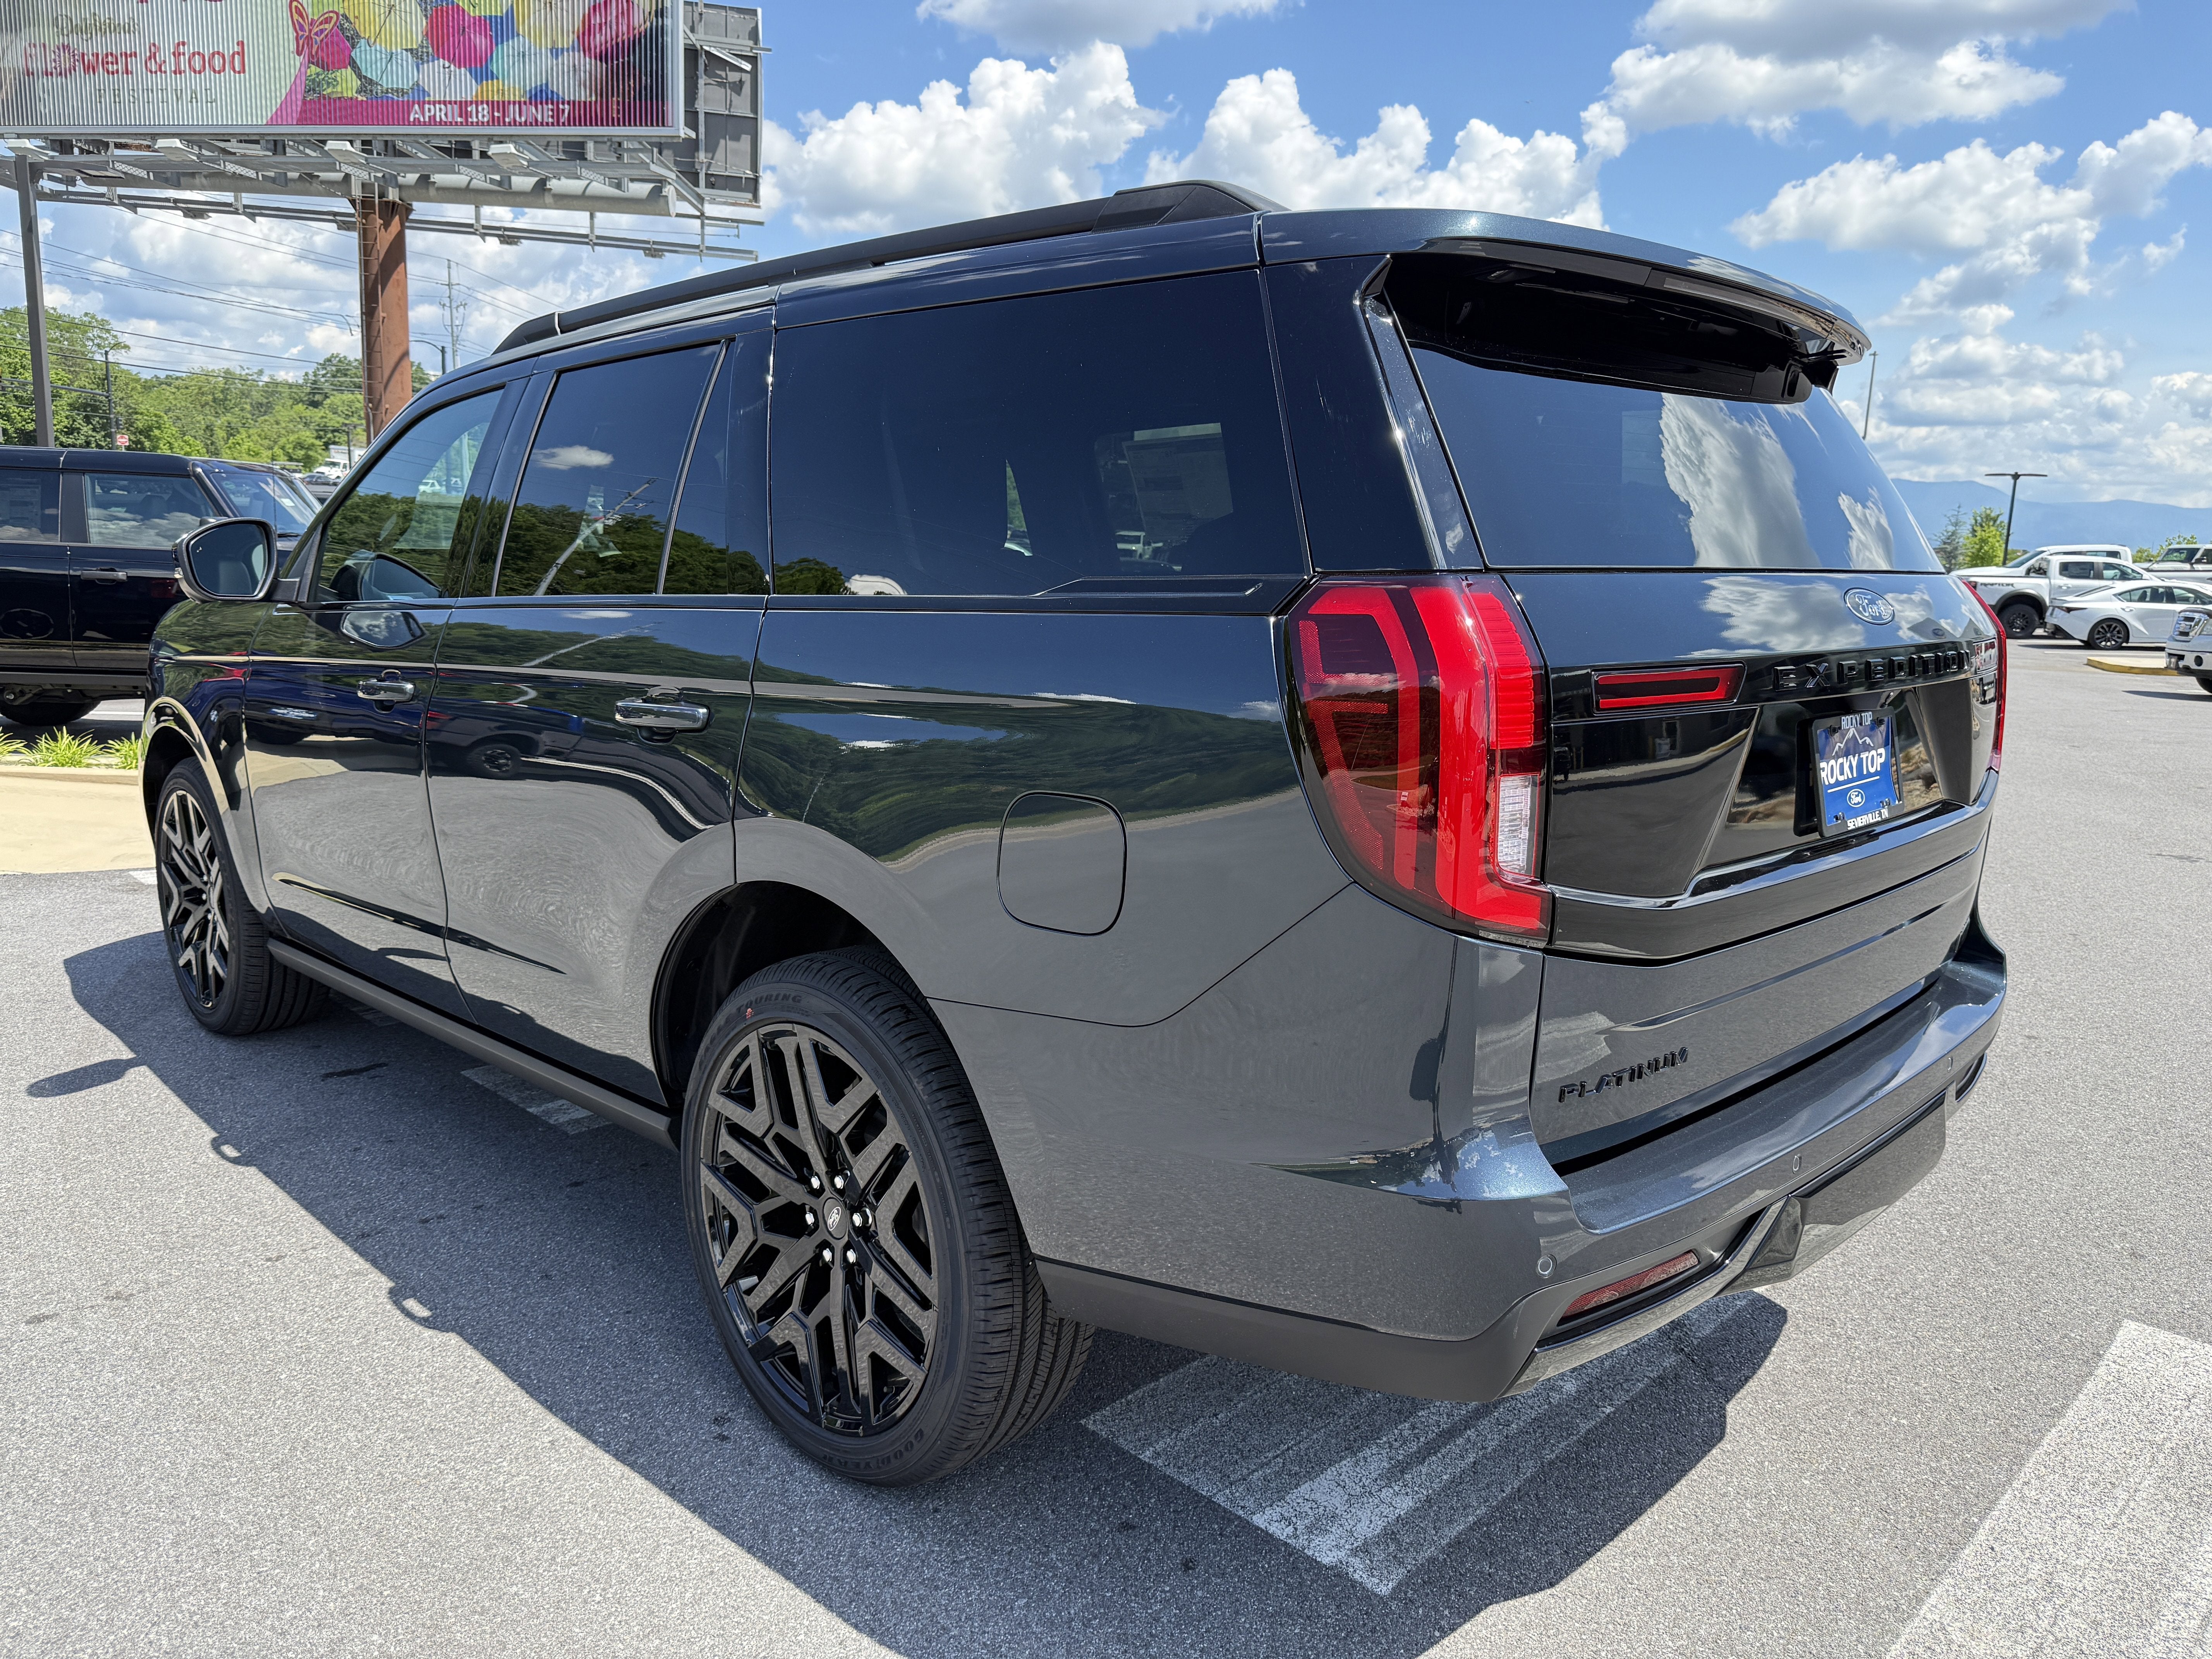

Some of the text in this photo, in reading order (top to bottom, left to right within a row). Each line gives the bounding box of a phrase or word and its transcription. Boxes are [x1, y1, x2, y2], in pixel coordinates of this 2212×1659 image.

[172, 40, 246, 75] food
[97, 89, 215, 103] FESTIVAL
[410, 104, 463, 122] APRIL
[467, 104, 489, 122] 18
[505, 104, 554, 122] JUNE
[560, 104, 570, 122] 7
[1855, 594, 1887, 617] Ford
[1772, 649, 1970, 692] EXPEDITION
[1841, 711, 1872, 730] ROCKY TOP
[1820, 747, 1885, 785] ROCKY TOP
[1850, 792, 1862, 804] Ford
[1881, 808, 1888, 818] TN
[736, 993, 803, 1013] TOURING
[1558, 1046, 1689, 1103] PLATINUM
[822, 1428, 924, 1470] GOODYEAR
